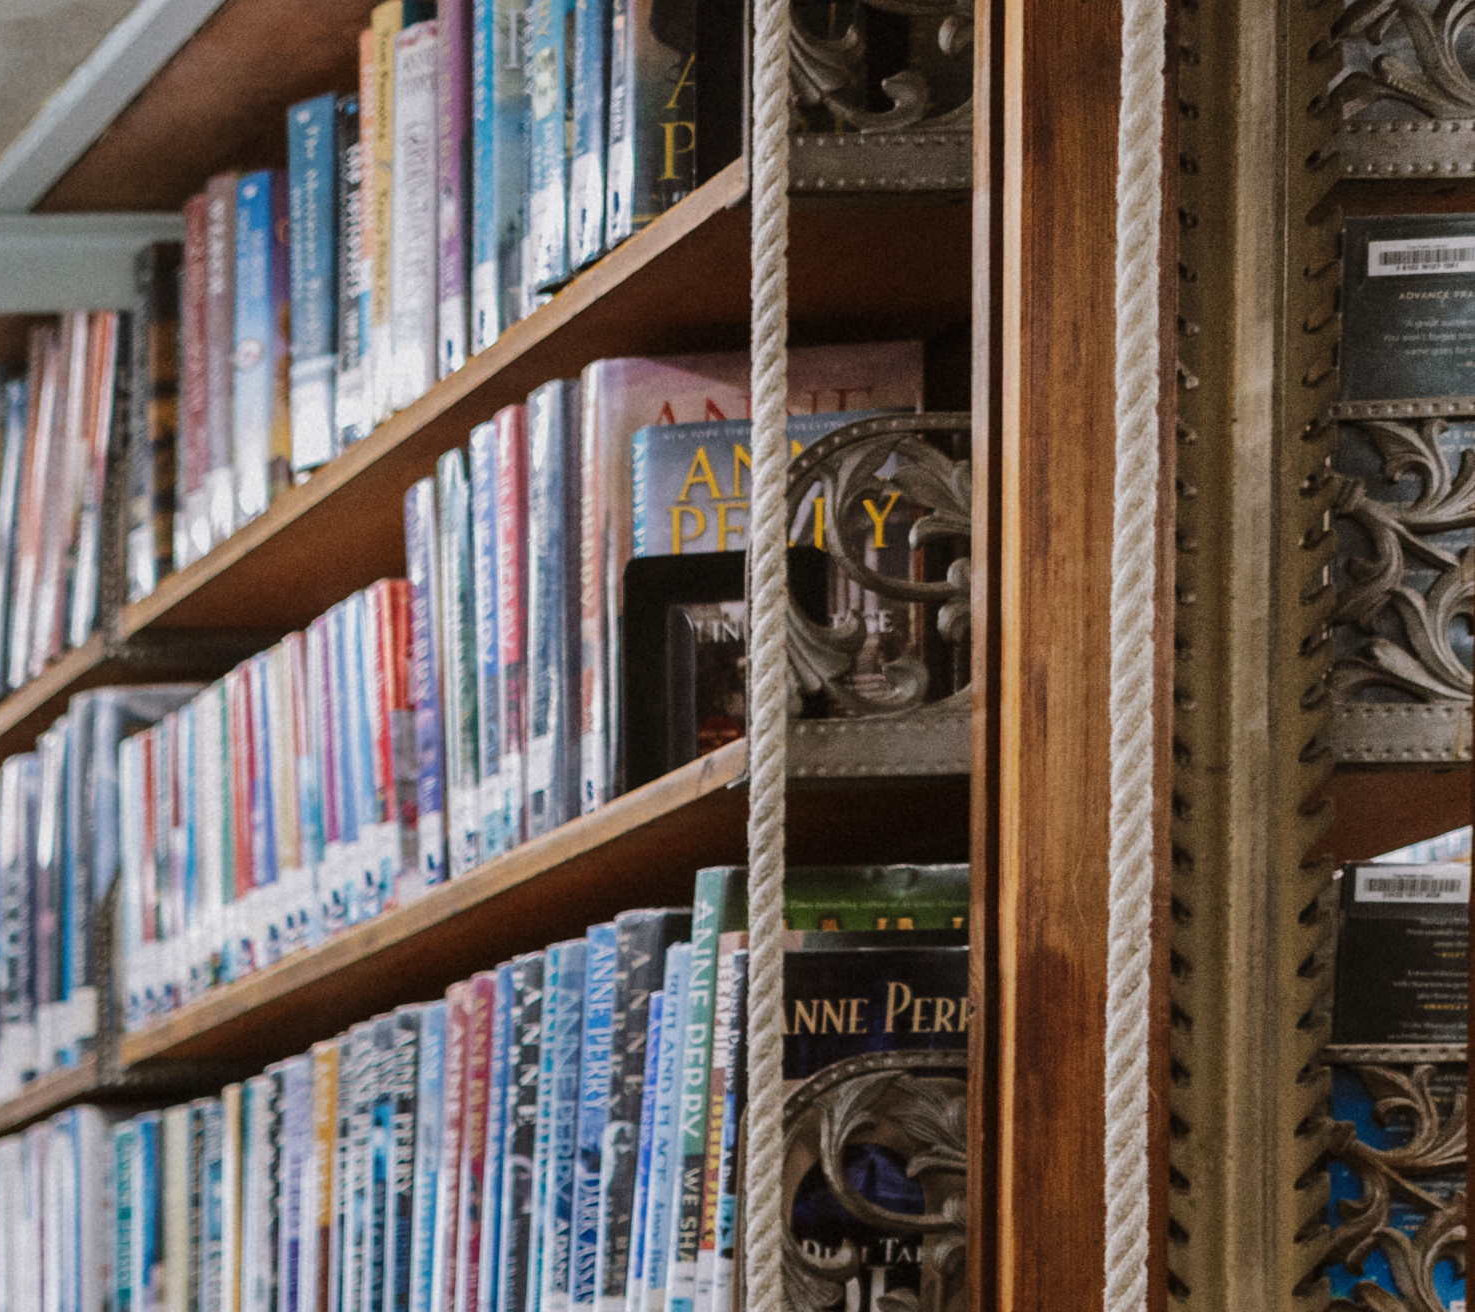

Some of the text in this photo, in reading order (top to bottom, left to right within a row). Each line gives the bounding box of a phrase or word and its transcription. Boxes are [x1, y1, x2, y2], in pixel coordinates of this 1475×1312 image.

[668, 490, 902, 554] PEY
[583, 943, 614, 1112] ANNE PERRY
[678, 900, 715, 1138] ANNE PERRY
[882, 980, 969, 1034] PER
[677, 1166, 702, 1264] WE SHA
